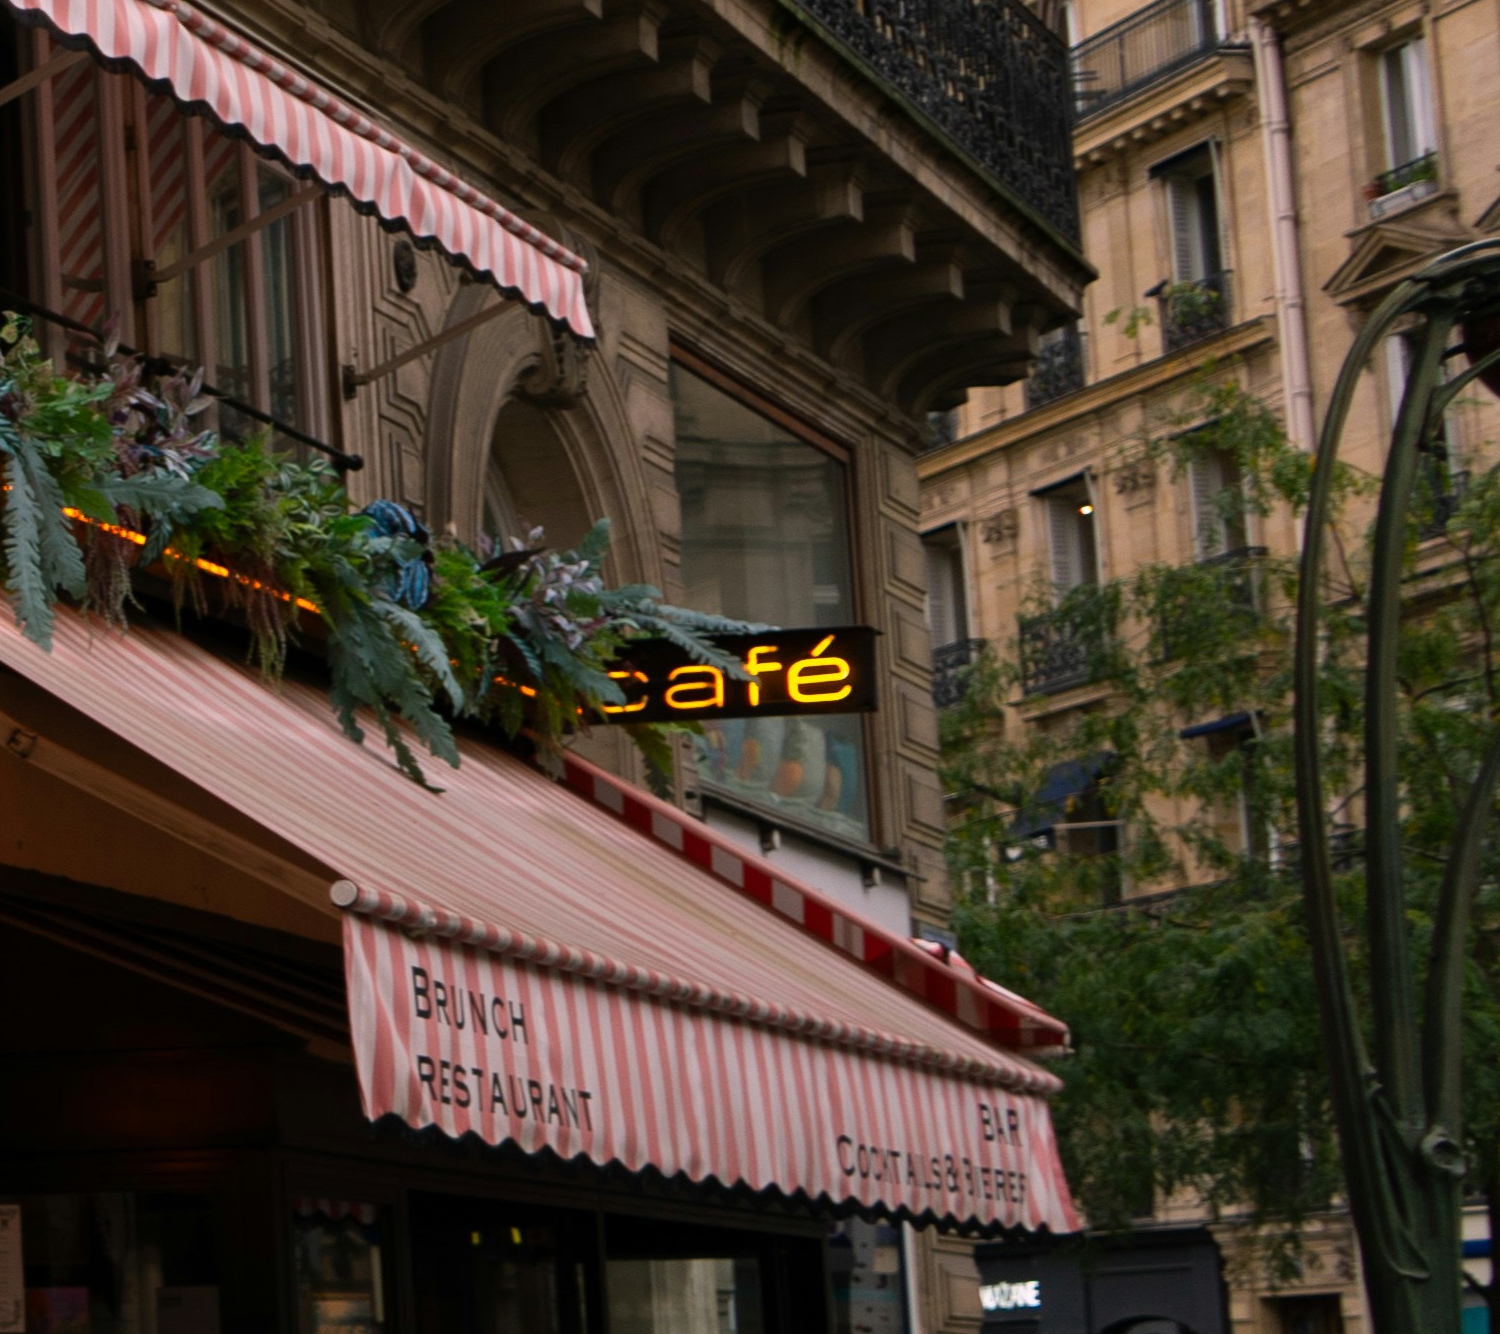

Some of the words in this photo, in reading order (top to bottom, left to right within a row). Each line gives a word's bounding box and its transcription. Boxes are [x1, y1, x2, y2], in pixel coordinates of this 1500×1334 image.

[586, 634, 853, 714] café
[411, 966, 529, 1046] BRUNCH
[416, 1054, 594, 1133] RESTAURANT
[978, 1103, 1024, 1147] BAR
